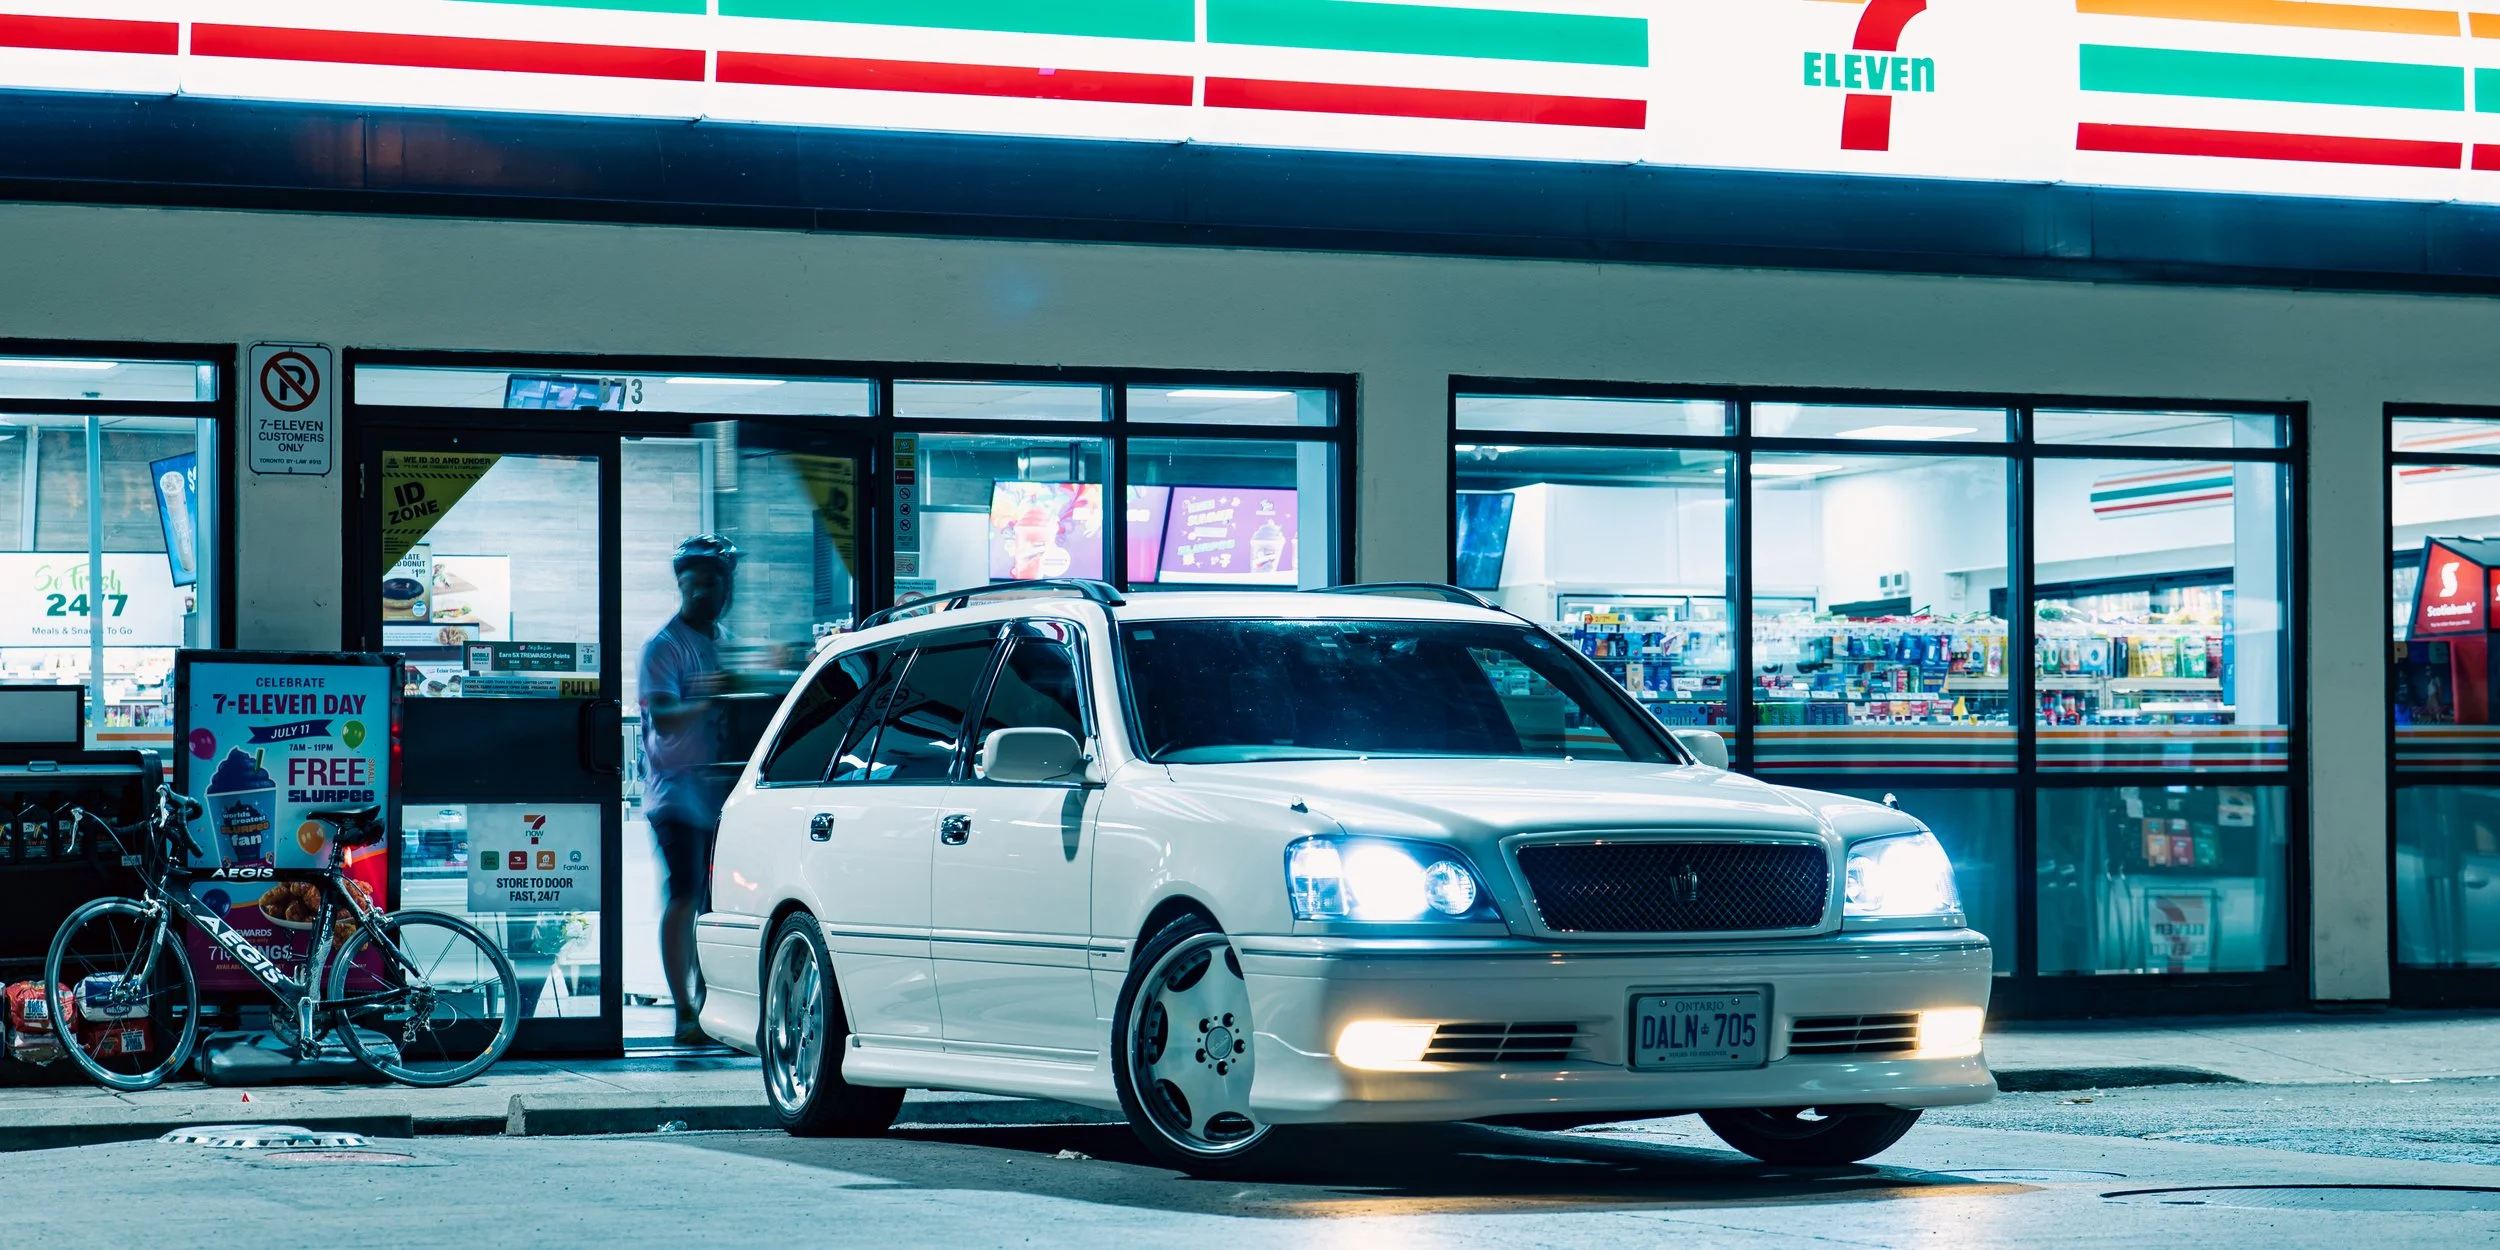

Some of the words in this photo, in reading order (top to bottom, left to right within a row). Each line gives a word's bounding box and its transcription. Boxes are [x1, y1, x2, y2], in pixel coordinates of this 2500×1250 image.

[600, 377, 643, 404] 873
[260, 419, 323, 431] 7-ELEVEN
[259, 432, 324, 442] CUSTOMERS
[279, 443, 304, 452] ONLY
[404, 456, 416, 464] WE
[394, 482, 425, 507] ID
[388, 500, 440, 525] ZONE
[34, 565, 63, 592] So
[65, 563, 121, 595] Frsh
[46, 594, 128, 617] 247
[32, 627, 59, 635] Meals
[62, 627, 69, 635] &
[72, 627, 103, 635] Sna
[107, 627, 118, 635] To
[120, 627, 132, 635] Go
[256, 677, 325, 687] CELEBRATE
[562, 680, 597, 696] PULL
[324, 694, 366, 714] DAY
[271, 726, 297, 739] JULY
[300, 724, 310, 734] 11
[288, 758, 366, 785] FREE
[524, 815, 546, 844] 7
[232, 834, 262, 846] fan
[211, 868, 274, 878] AEGIS
[497, 878, 528, 888] STORE
[531, 878, 543, 888] TO
[545, 878, 573, 888] DOOR
[510, 891, 536, 903] FAST,
[538, 891, 560, 901] 24/7
[235, 929, 272, 937] EWARDS
[195, 915, 280, 984] AEGIS
[1675, 1001, 1725, 1013] ONTARIO
[1642, 1015, 1699, 1049] DALN
[1714, 1013, 1757, 1047] 705
